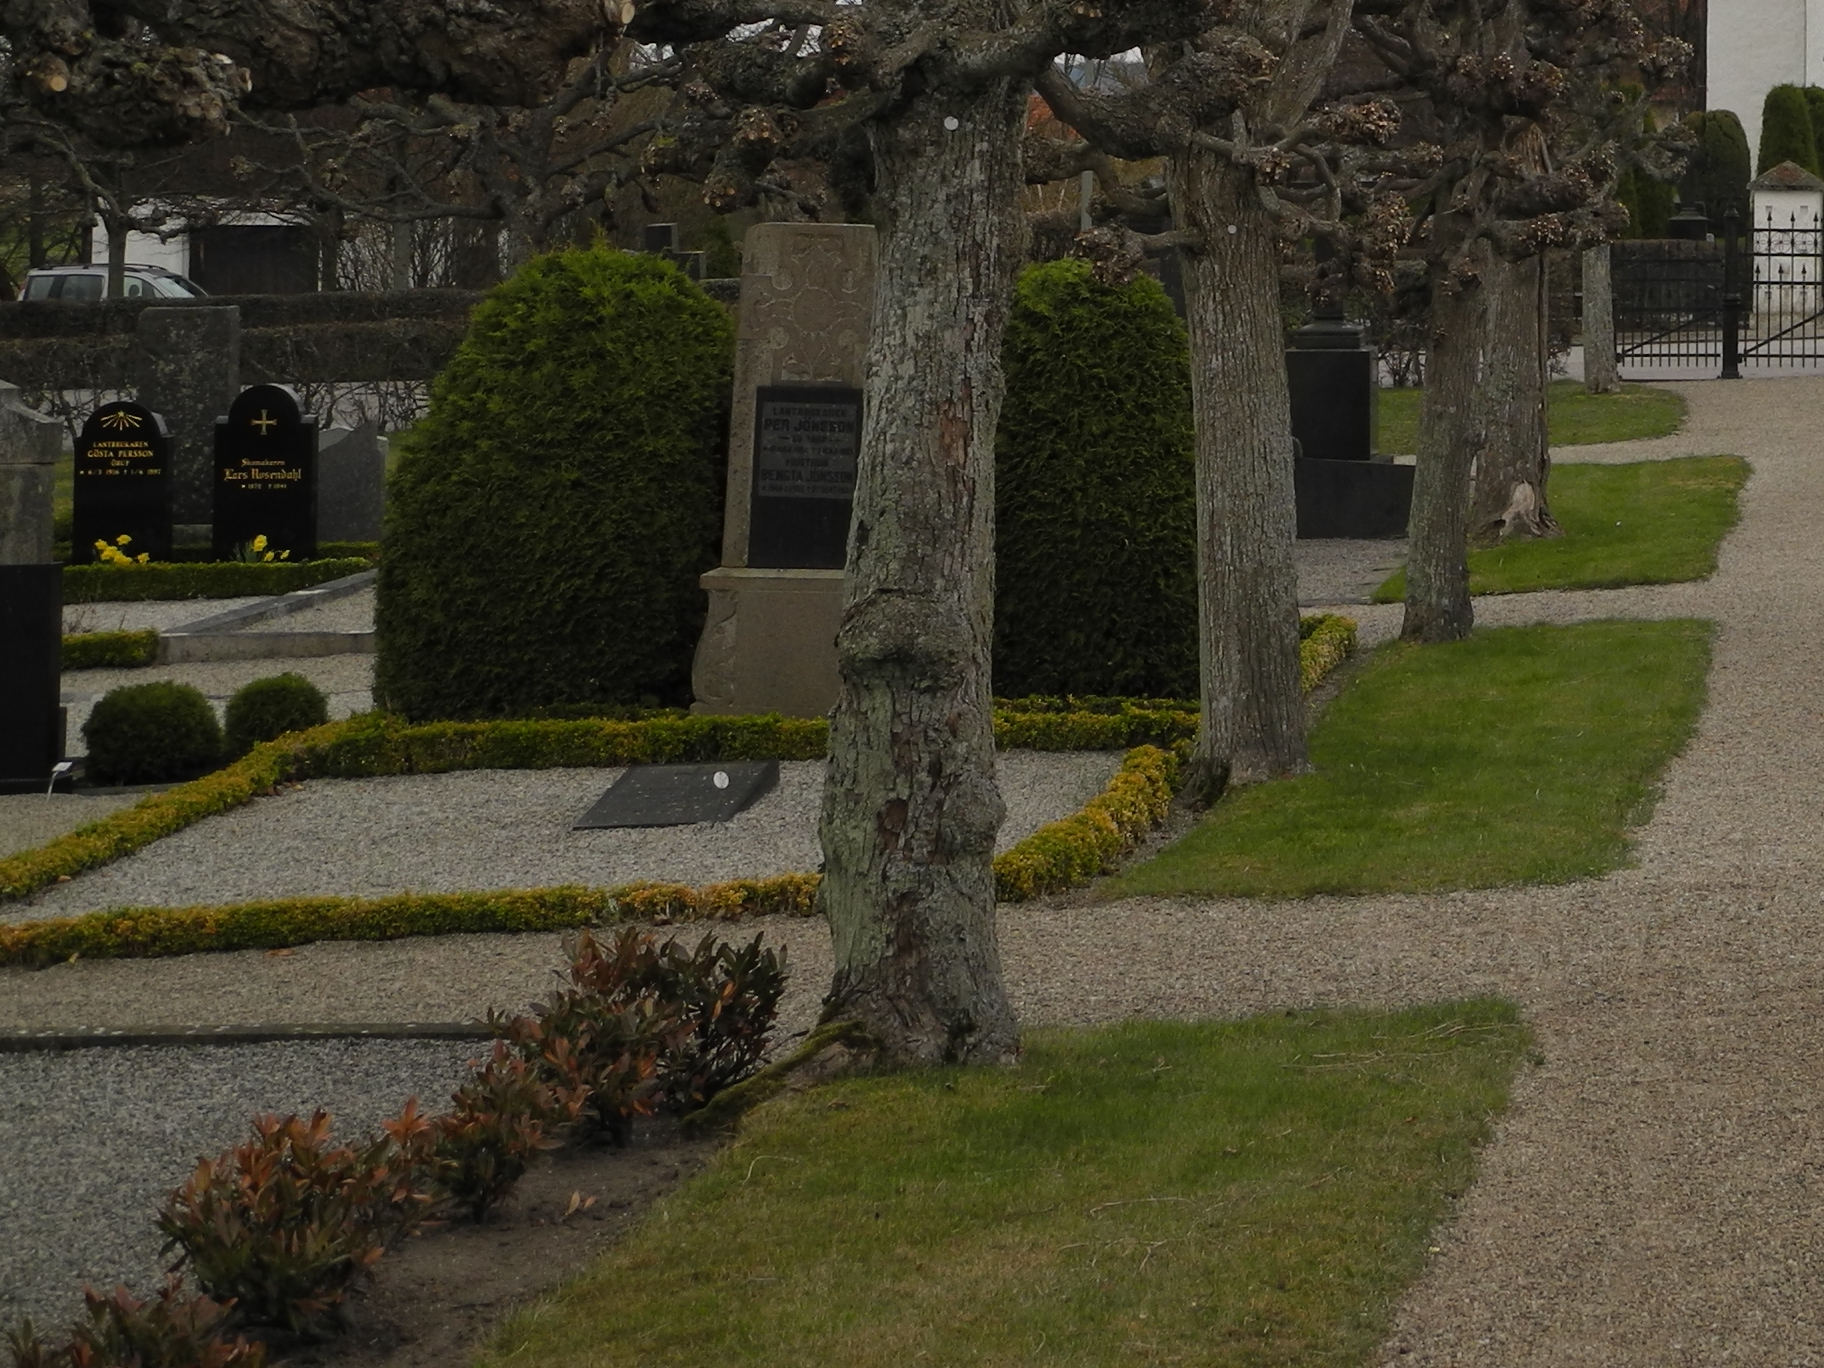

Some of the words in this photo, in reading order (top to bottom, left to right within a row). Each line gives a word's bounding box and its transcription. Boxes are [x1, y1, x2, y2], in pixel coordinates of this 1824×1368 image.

[764, 418, 790, 431] PER
[794, 416, 854, 433] JÖNSSON
[87, 449, 114, 458] GÖSTA
[118, 450, 154, 458] PERSSON
[223, 468, 248, 482] Lars
[251, 468, 302, 482] Rosendahl
